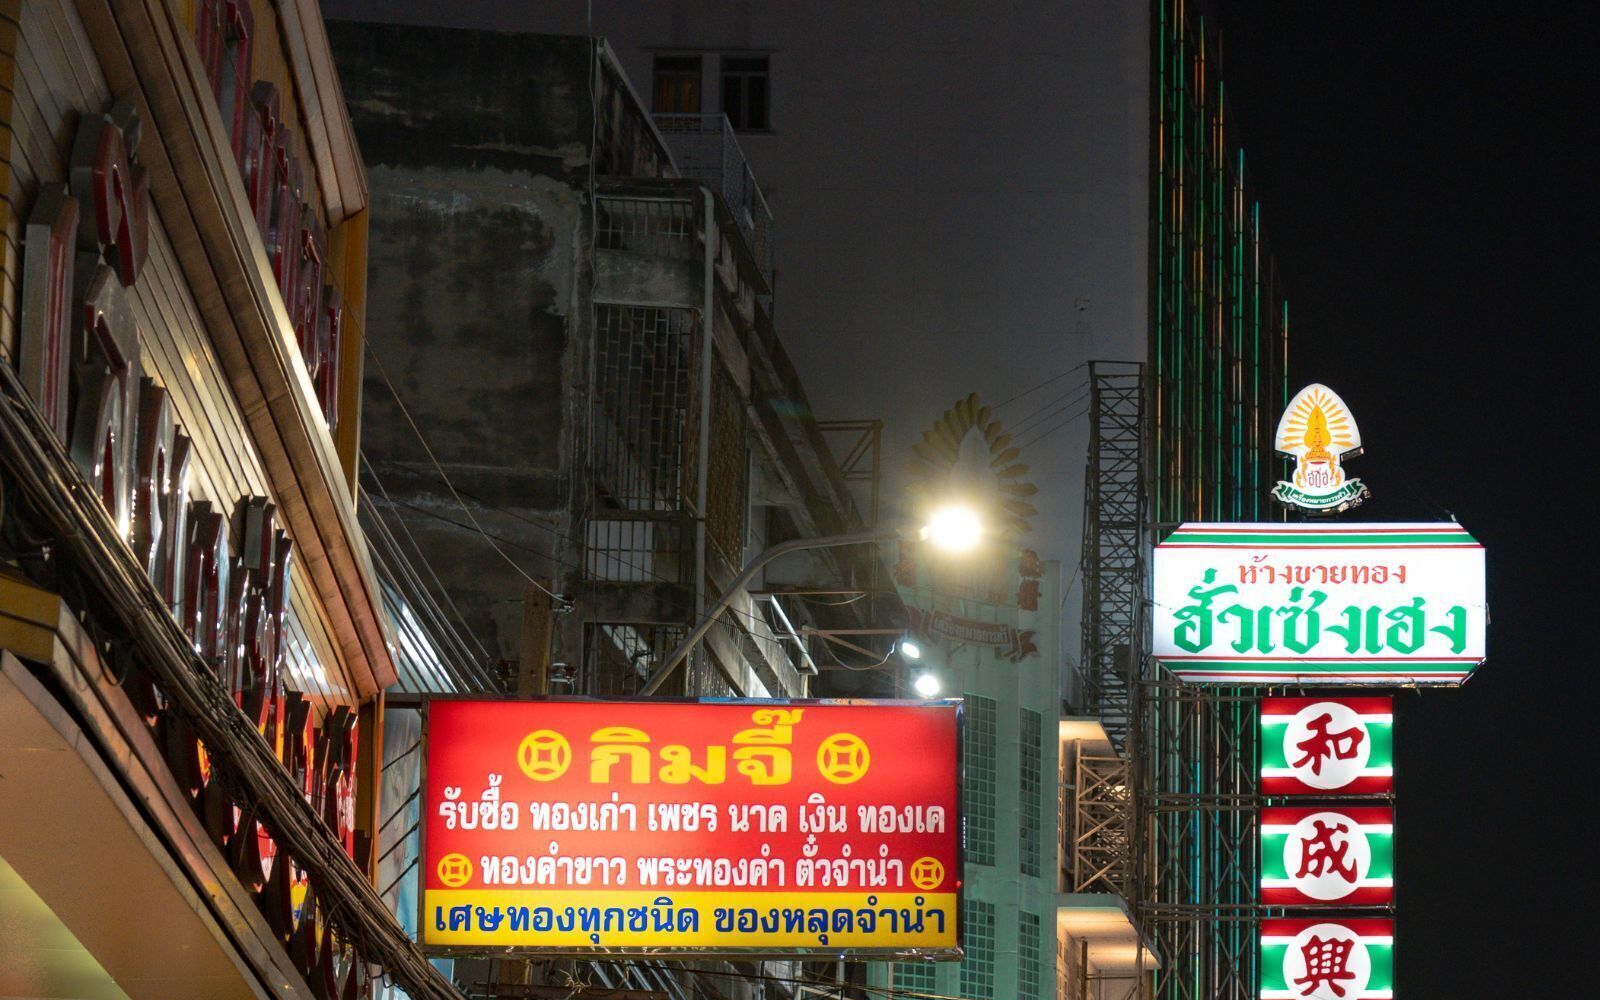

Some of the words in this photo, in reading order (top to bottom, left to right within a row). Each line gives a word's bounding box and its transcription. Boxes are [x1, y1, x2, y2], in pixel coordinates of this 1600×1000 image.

[1238, 555, 1407, 585] ห้างขายทอง
[1172, 568, 1467, 655] ฮั่วเซ่งเฮง
[589, 708, 806, 786] กิมจี๊
[439, 773, 519, 831] รับซื้อ
[529, 792, 637, 832] ทองเก่า
[648, 801, 718, 833] เพชร
[728, 803, 788, 833] นาค
[799, 792, 848, 833] เงิน
[857, 804, 946, 834] ทองเค
[480, 841, 627, 886] ทองคำขาว
[636, 843, 785, 887] พระทองคำ
[795, 834, 904, 887] ตั๋วจำนำ
[435, 896, 699, 945] เศษทองทุกชนิด
[713, 895, 946, 946] ของหลุดจำนำ
